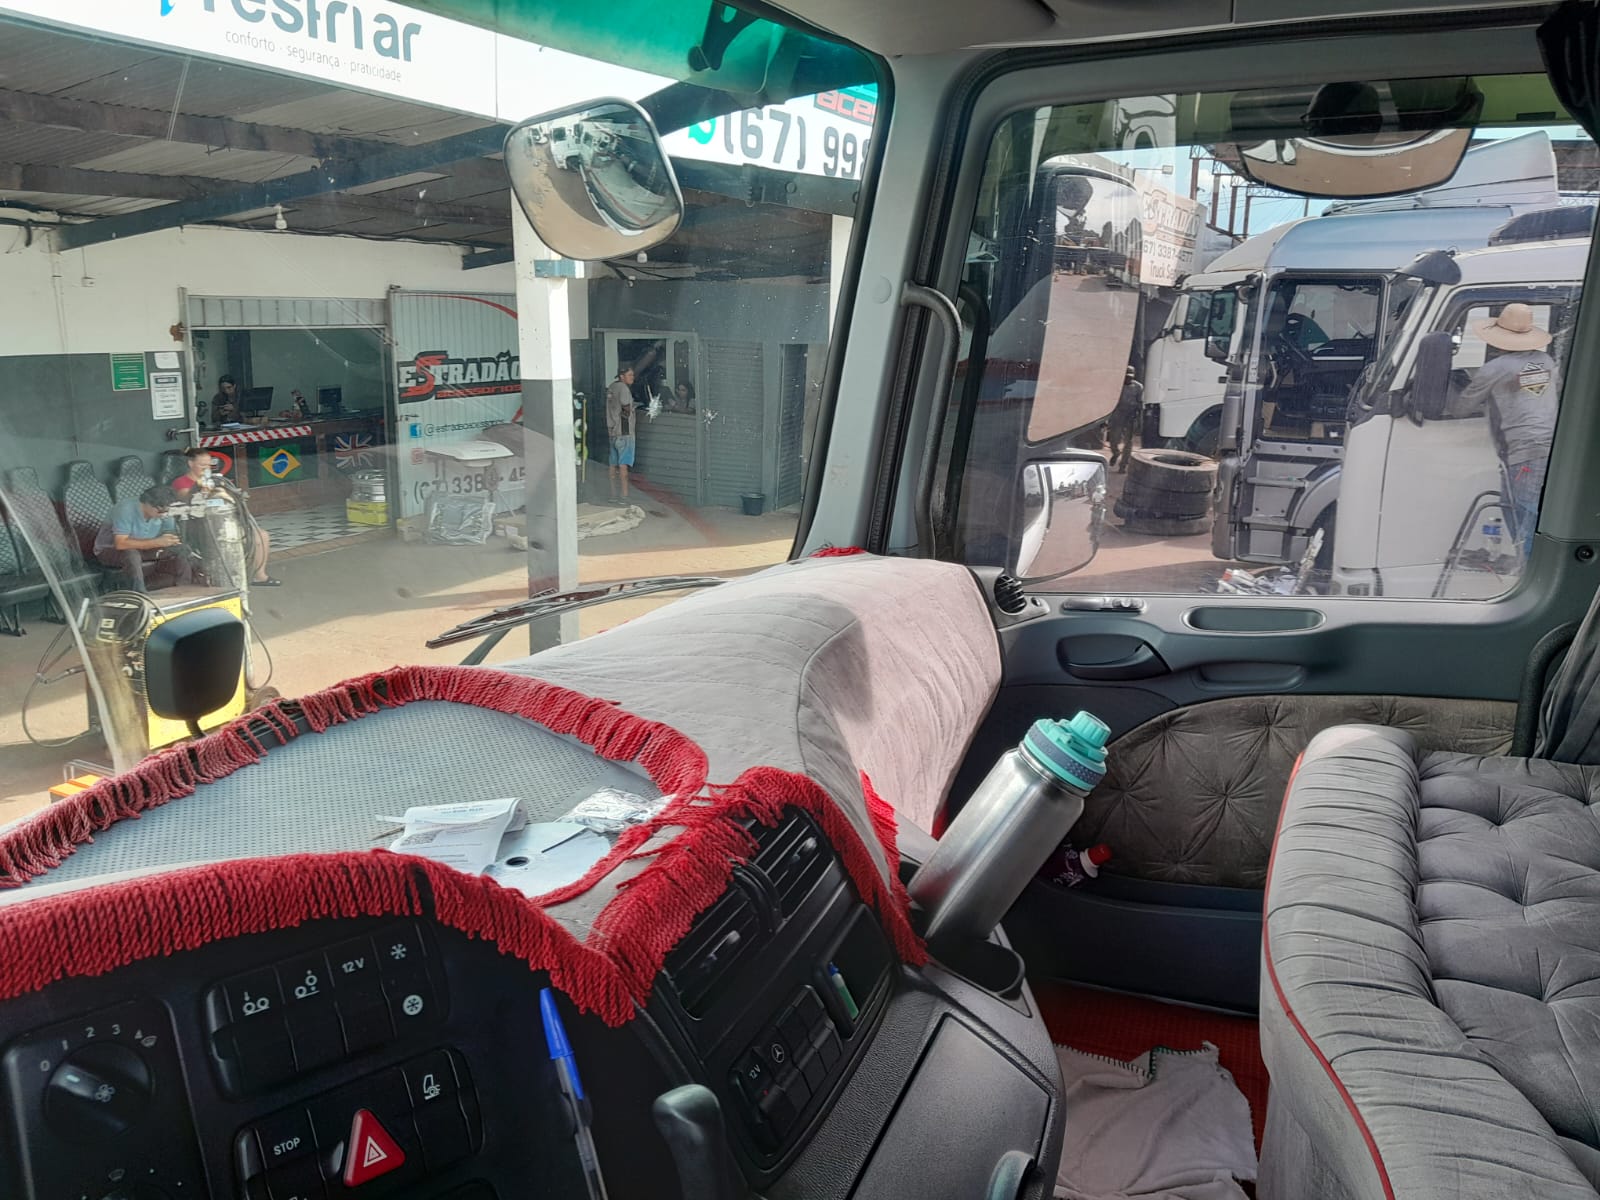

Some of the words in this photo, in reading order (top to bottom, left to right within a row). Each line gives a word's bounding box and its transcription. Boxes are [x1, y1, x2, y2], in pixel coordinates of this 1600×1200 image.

[203, 0, 422, 62] esfriar
[225, 30, 276, 53] conforto
[287, 44, 340, 69] segurança
[350, 61, 402, 82] praticidade
[817, 90, 875, 123] ace
[723, 108, 806, 170] (67)
[62, 1040, 69, 1051] 1
[85, 1026, 96, 1038] 2
[111, 1024, 121, 1035] 3
[134, 1029, 143, 1040] 4
[273, 1137, 301, 1156] STOP
